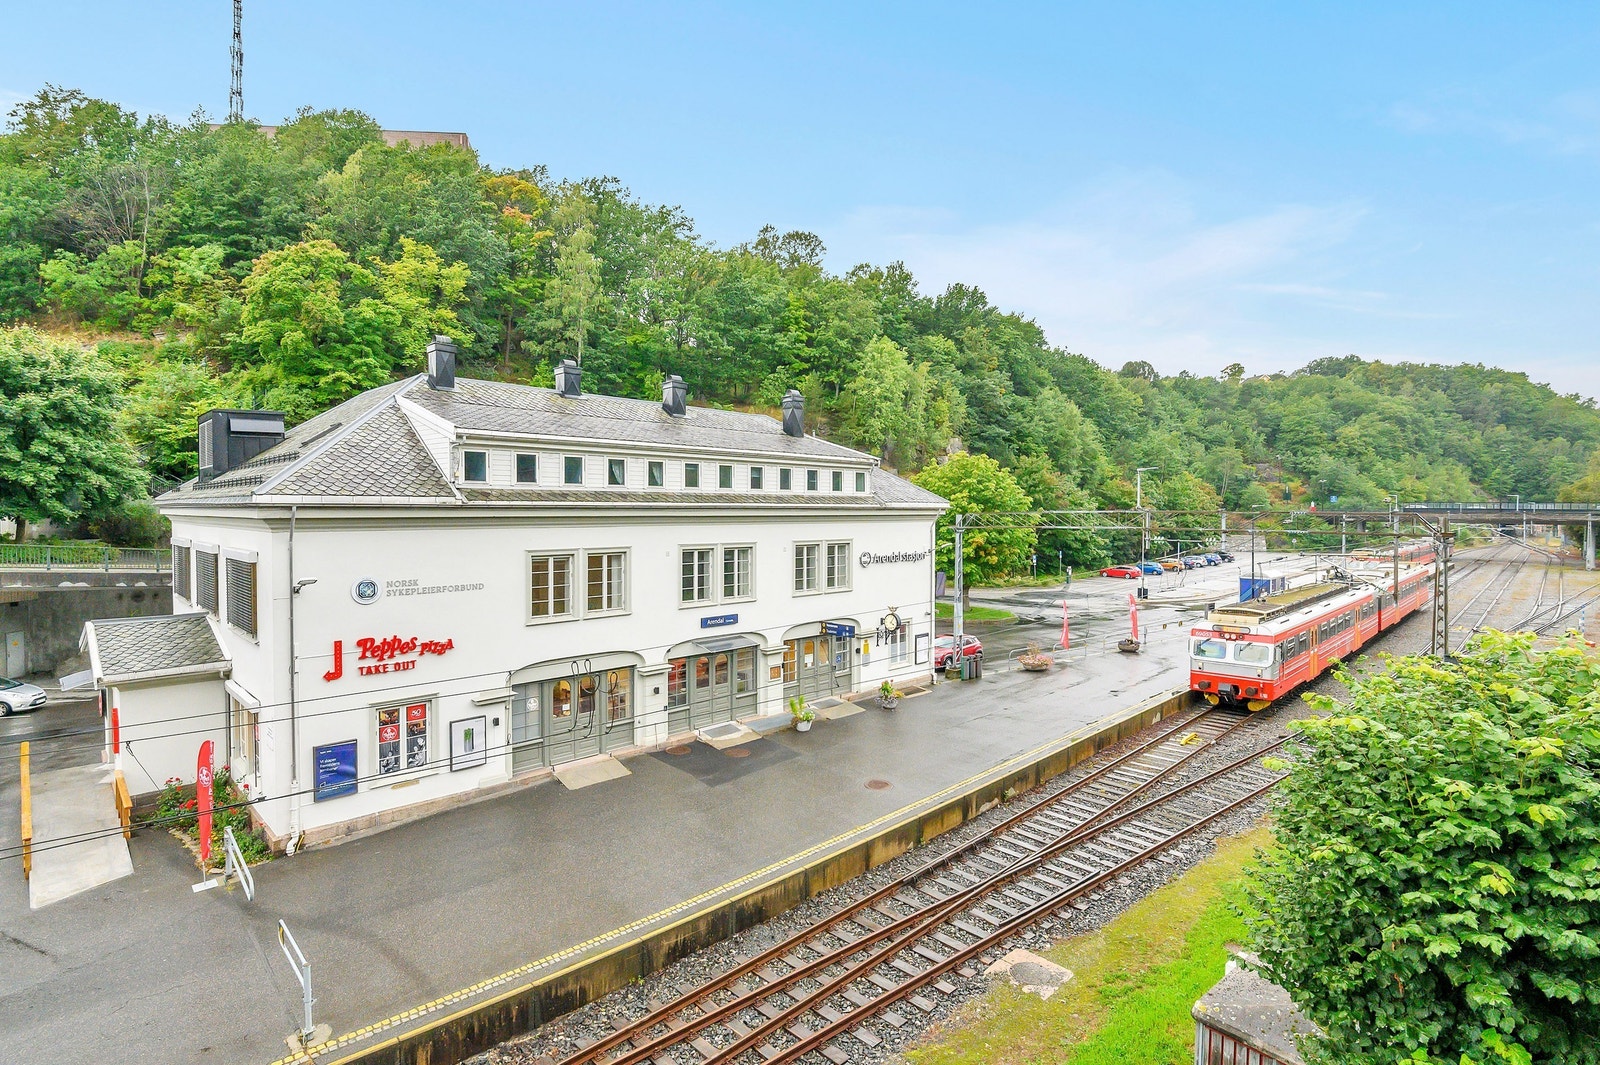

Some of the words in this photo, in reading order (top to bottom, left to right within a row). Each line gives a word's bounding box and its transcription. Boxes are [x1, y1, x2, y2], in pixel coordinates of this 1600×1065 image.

[872, 552, 900, 564] Arendal
[901, 551, 926, 563] stasjon
[386, 579, 419, 588] NORSK
[386, 583, 485, 597] SYKEPLEIERFORBUND
[356, 635, 418, 661] Peppes
[358, 663, 389, 676] TAKE
[394, 660, 417, 672] OUT
